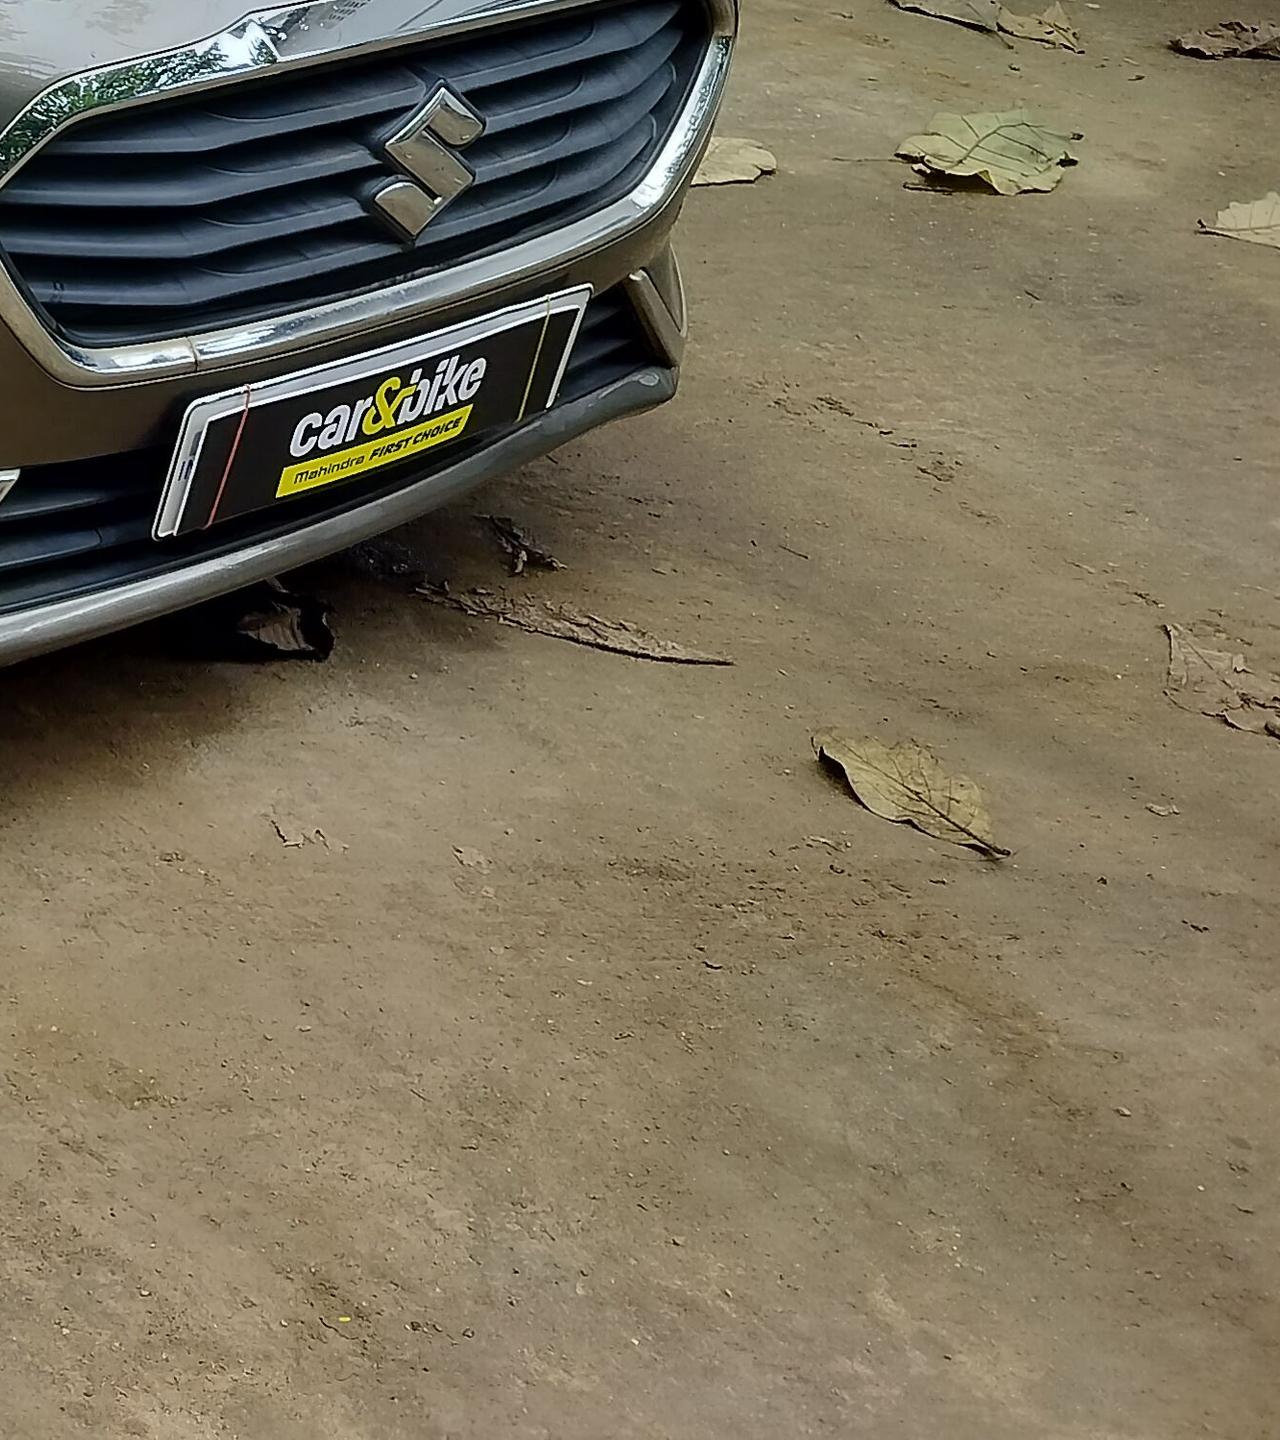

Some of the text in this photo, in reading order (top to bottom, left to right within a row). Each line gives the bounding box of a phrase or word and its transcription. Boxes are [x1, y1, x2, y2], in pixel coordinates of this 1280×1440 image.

[290, 355, 487, 457] car&bike
[368, 438, 415, 461] FIRST
[412, 416, 463, 445] CHOICE
